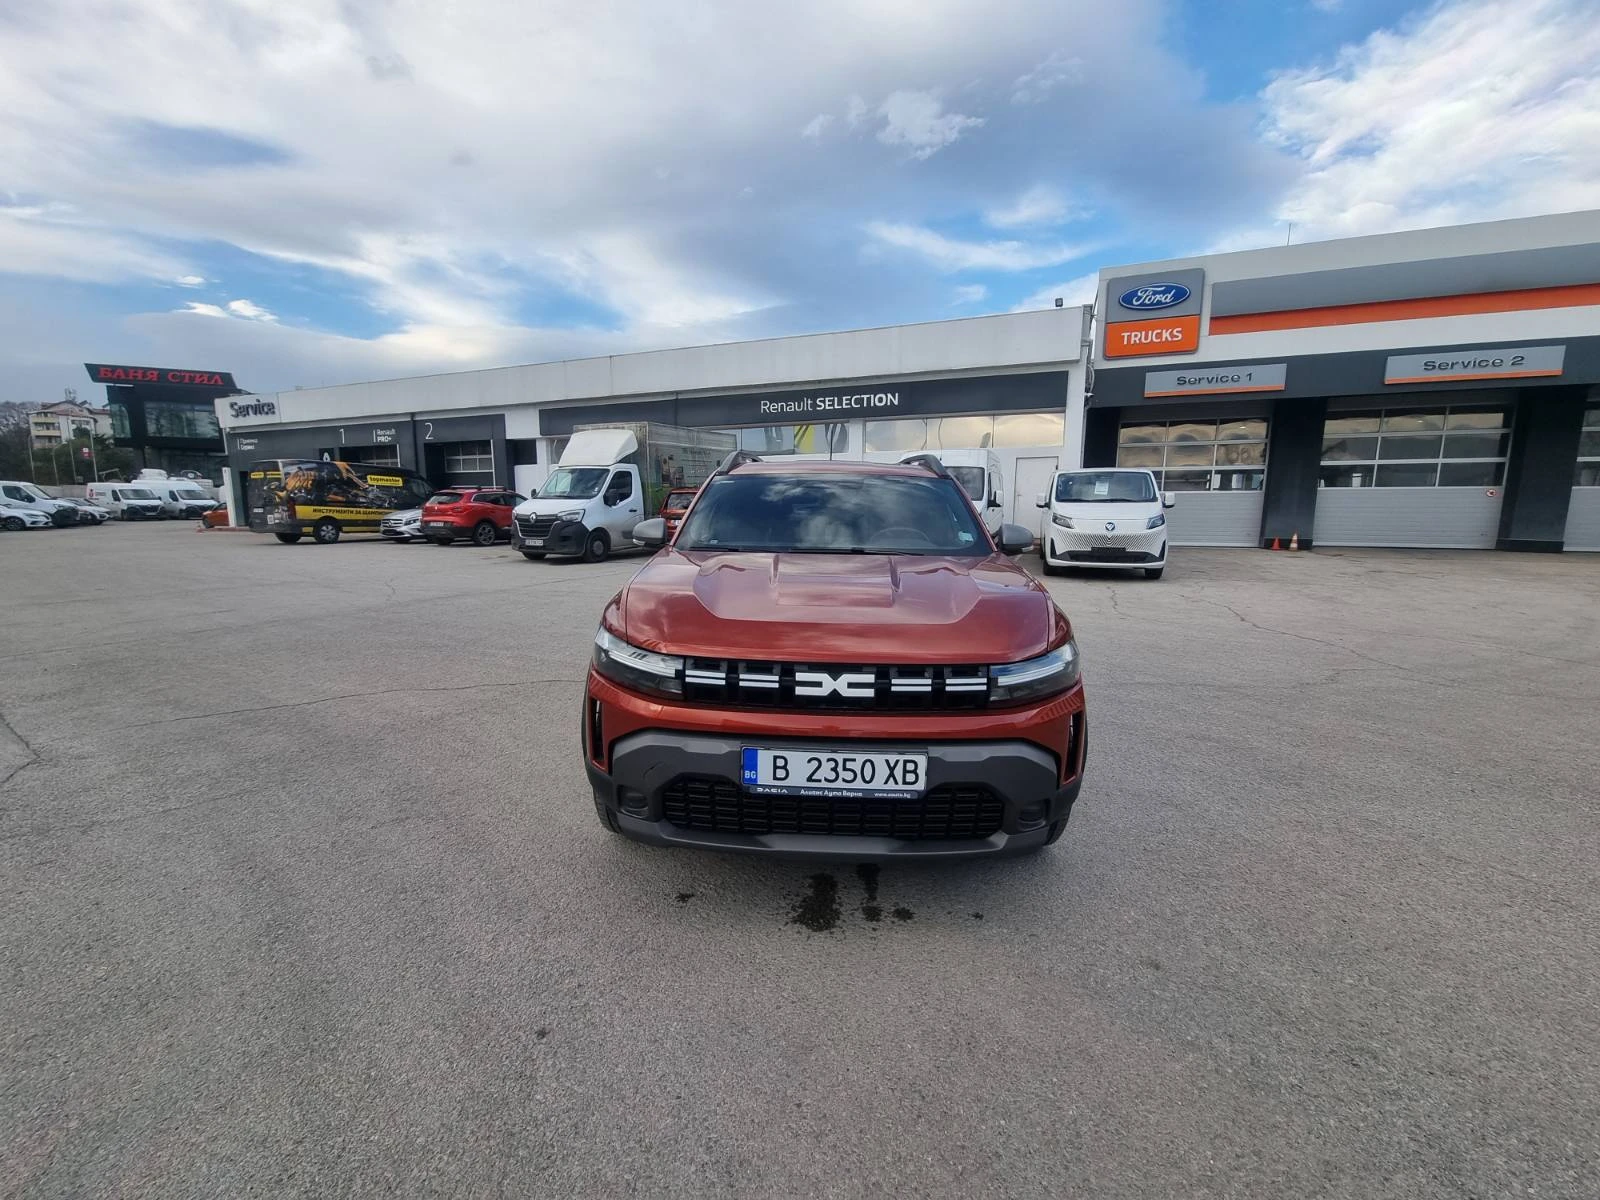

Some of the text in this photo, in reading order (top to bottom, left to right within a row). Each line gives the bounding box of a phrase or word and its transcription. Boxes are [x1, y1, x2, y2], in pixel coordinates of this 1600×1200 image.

[1132, 286, 1175, 306] Ford
[1121, 327, 1183, 345] TRUCKS
[1423, 355, 1525, 371] Service 2
[98, 367, 225, 386] БАНЯ СТИЛ
[1176, 372, 1253, 386] Service 1
[229, 398, 276, 418] Service
[760, 392, 899, 414] Renault SELECTION
[339, 428, 345, 444] 1
[424, 422, 434, 440] 2
[744, 770, 757, 779] BG
[772, 755, 919, 786] B 2350 XB
